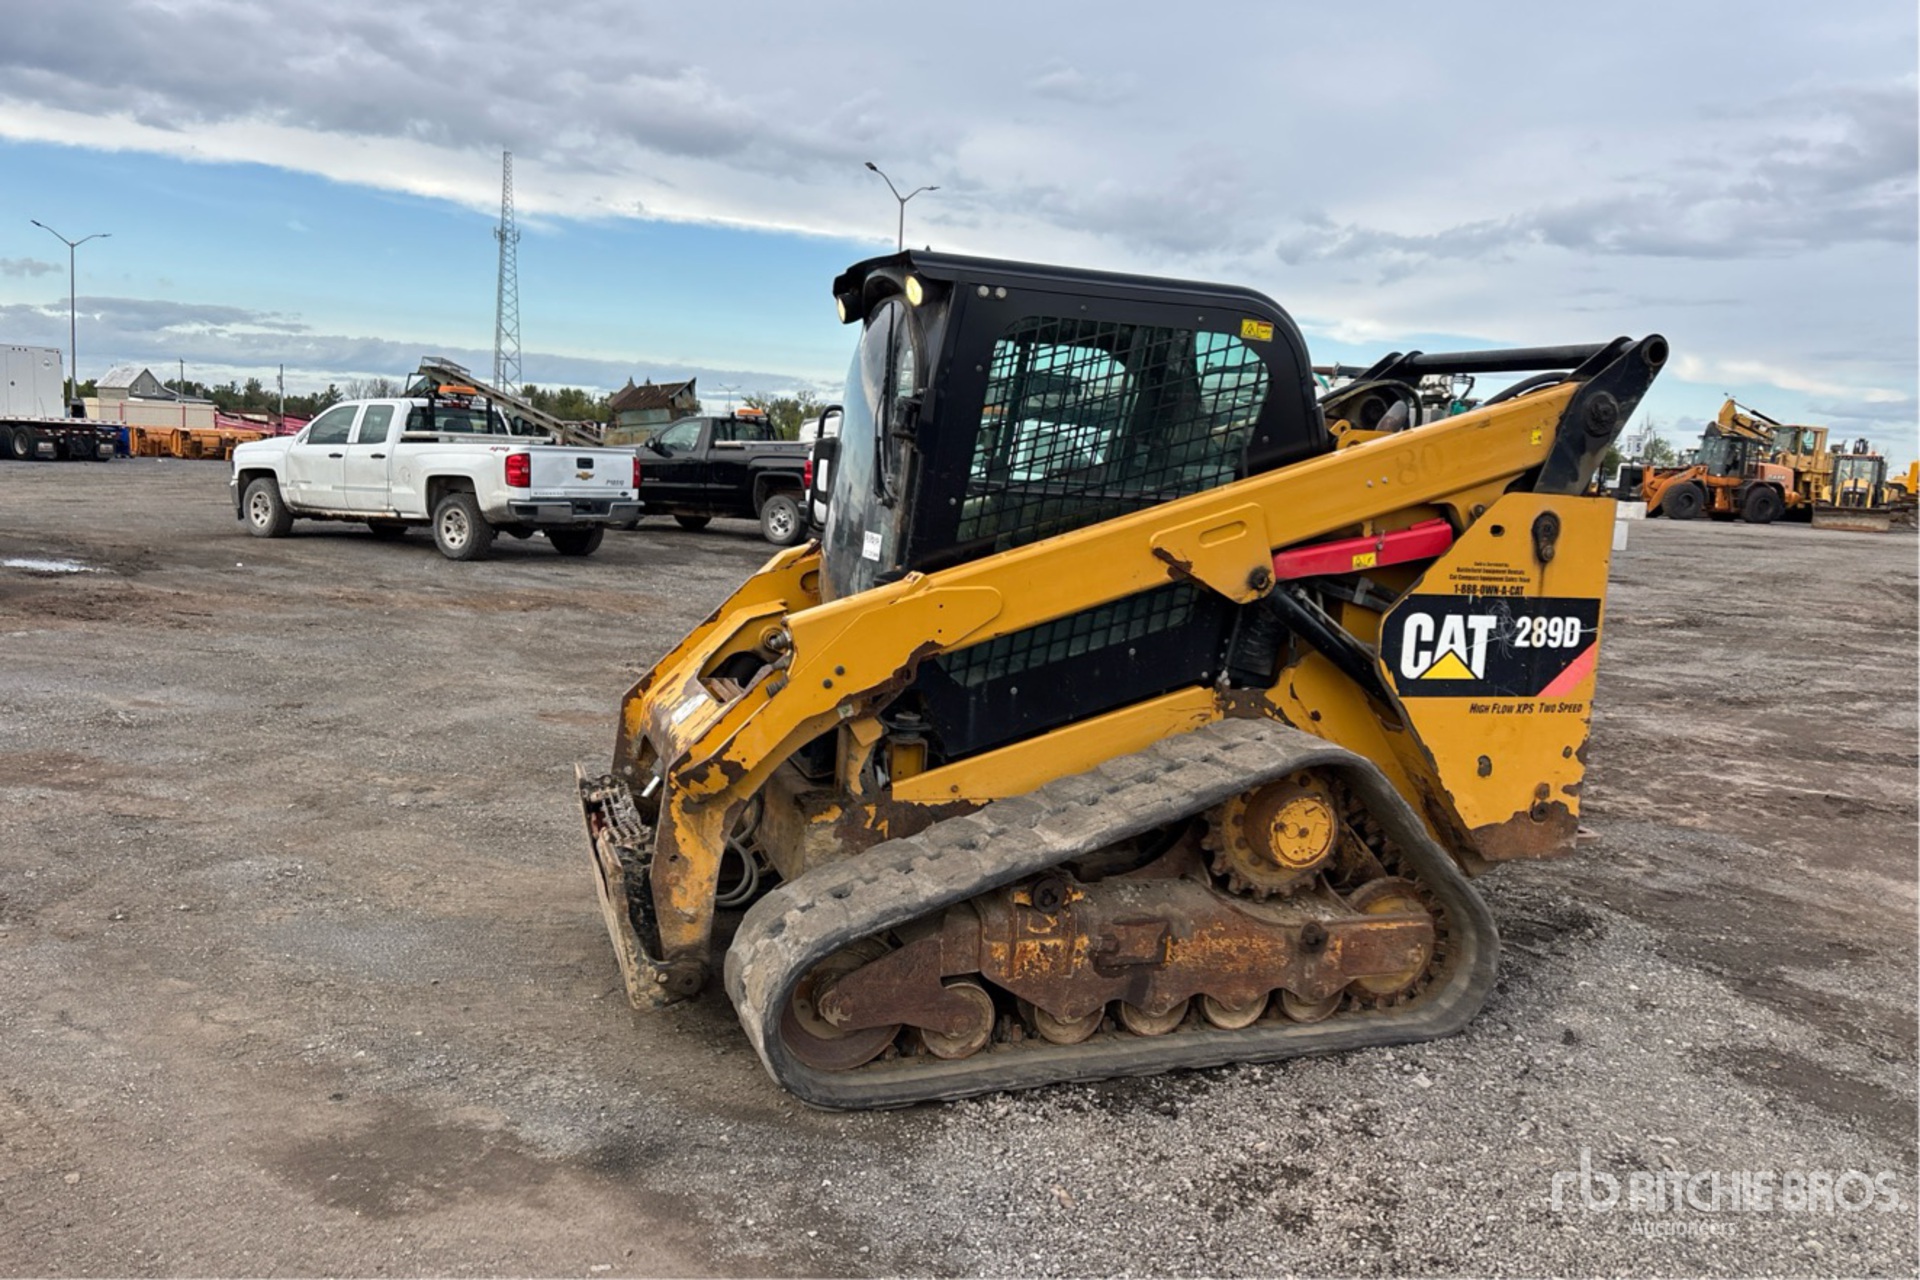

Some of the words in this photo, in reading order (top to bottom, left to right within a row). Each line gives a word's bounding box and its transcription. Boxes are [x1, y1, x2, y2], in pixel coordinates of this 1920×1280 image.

[1454, 584, 1525, 595] 1-888-OWN-A-CAT
[1400, 612, 1497, 680] CAT
[1514, 616, 1581, 648] 289D
[1516, 703, 1535, 714] XPS
